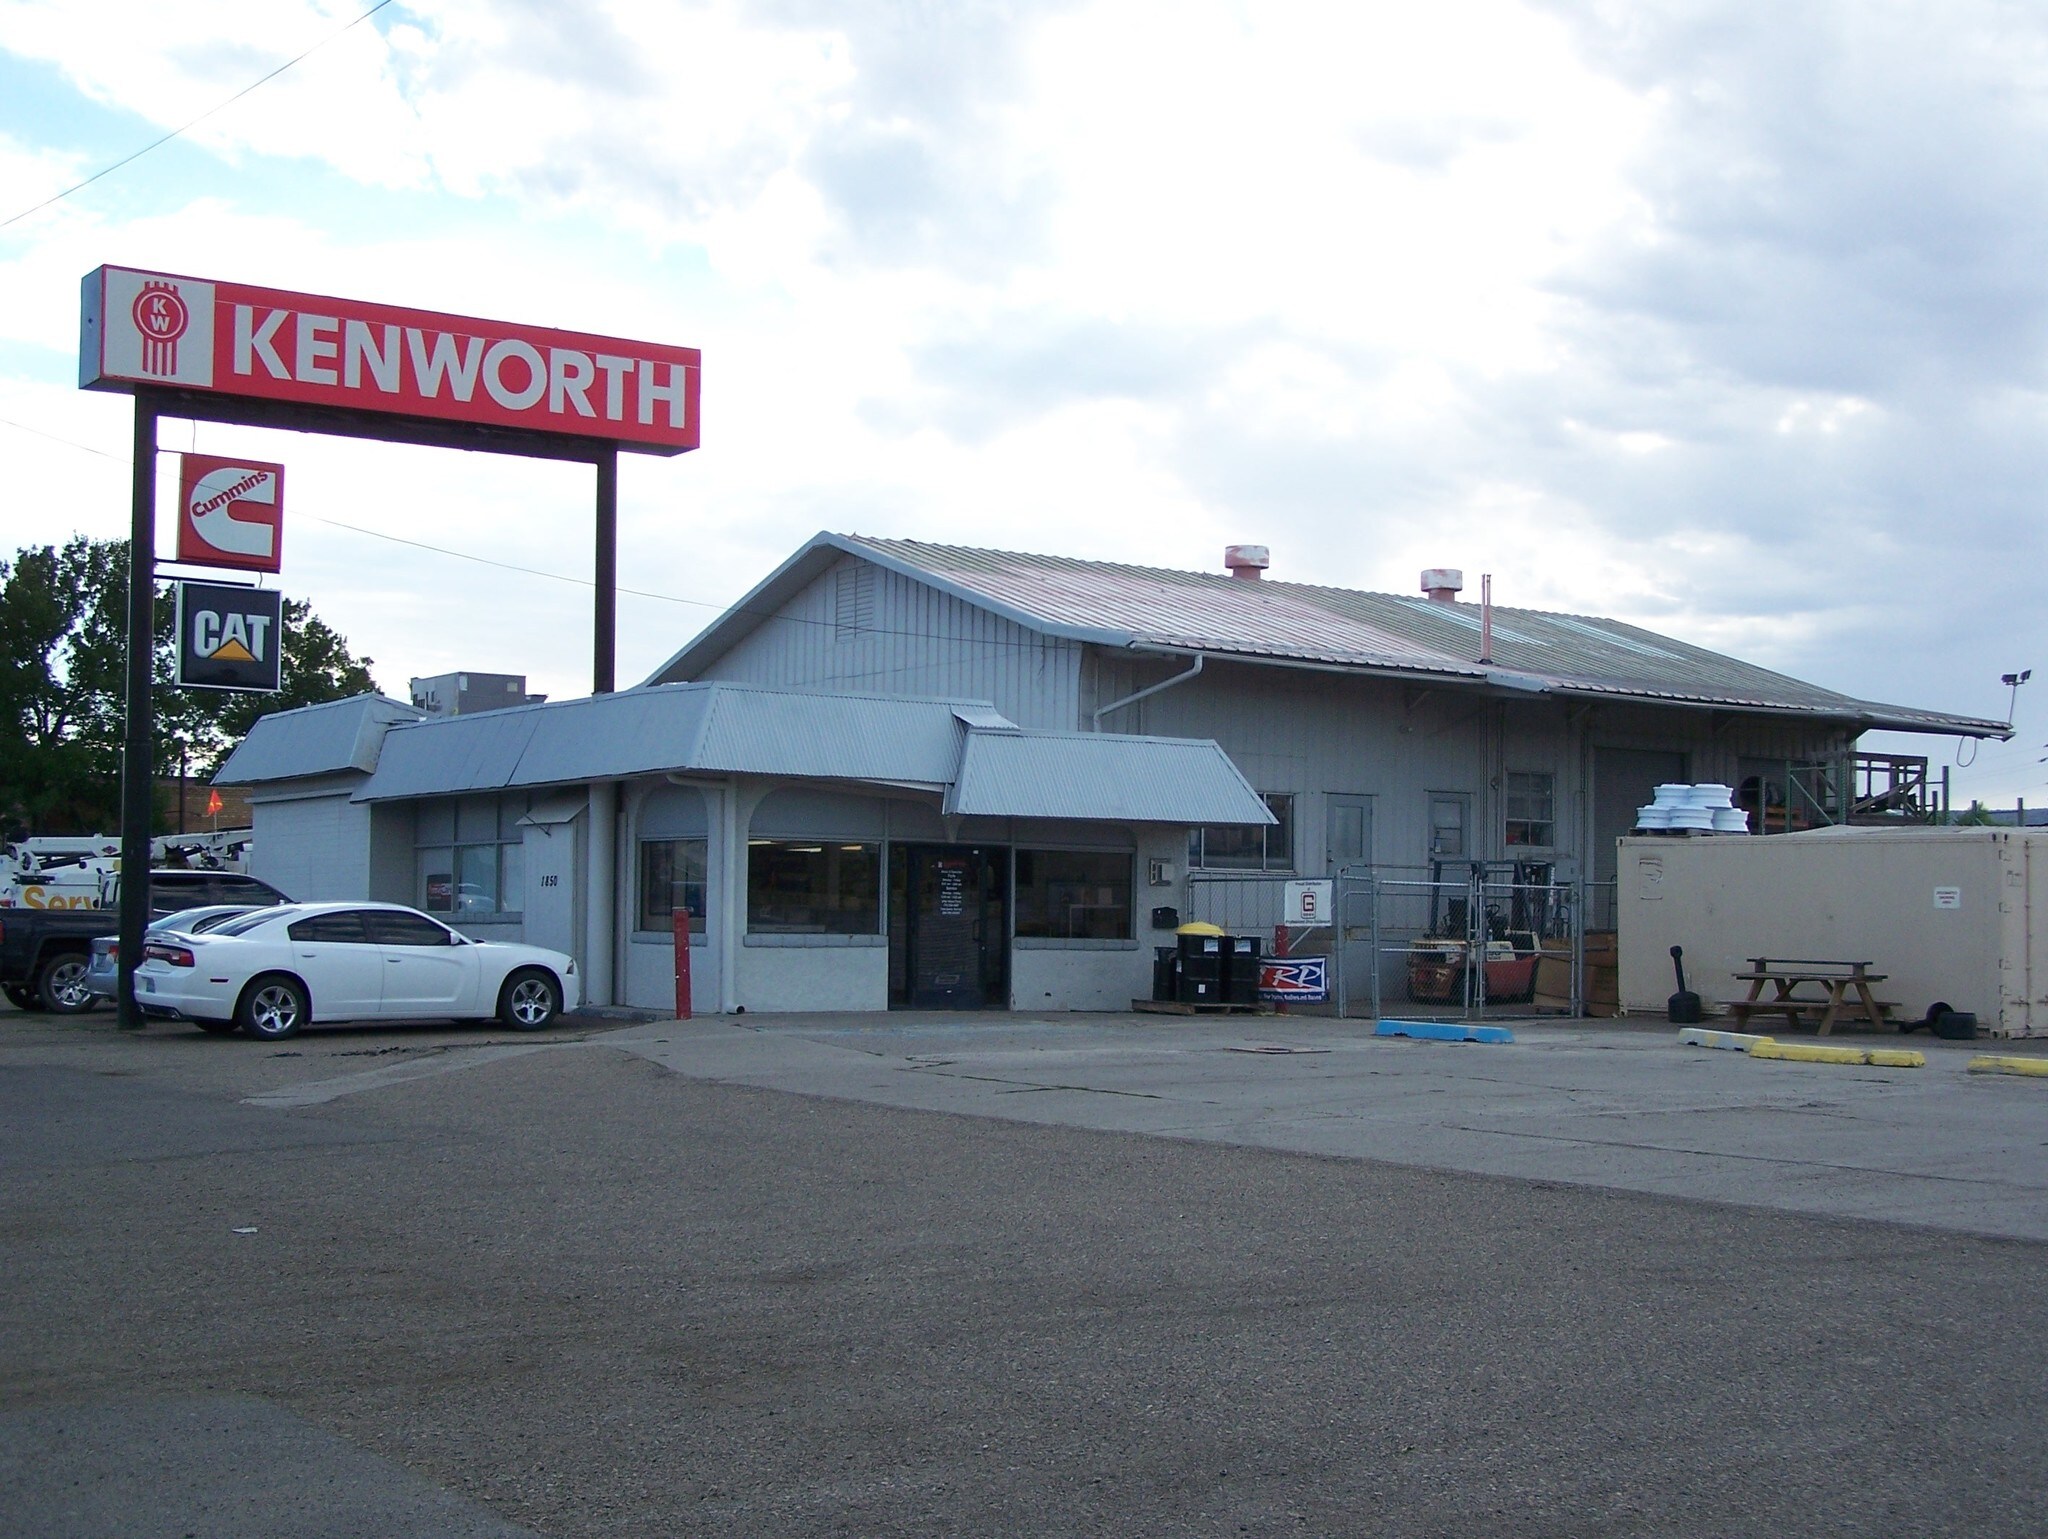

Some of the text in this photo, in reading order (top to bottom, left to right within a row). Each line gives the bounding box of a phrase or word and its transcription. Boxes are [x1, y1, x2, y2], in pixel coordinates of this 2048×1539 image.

[153, 298, 167, 315] K
[150, 314, 170, 332] W
[234, 304, 686, 429] KENWORTH
[191, 469, 268, 518] Cummins
[194, 610, 272, 662] CAT
[540, 875, 558, 887] 1850
[24, 886, 99, 910] Serv
